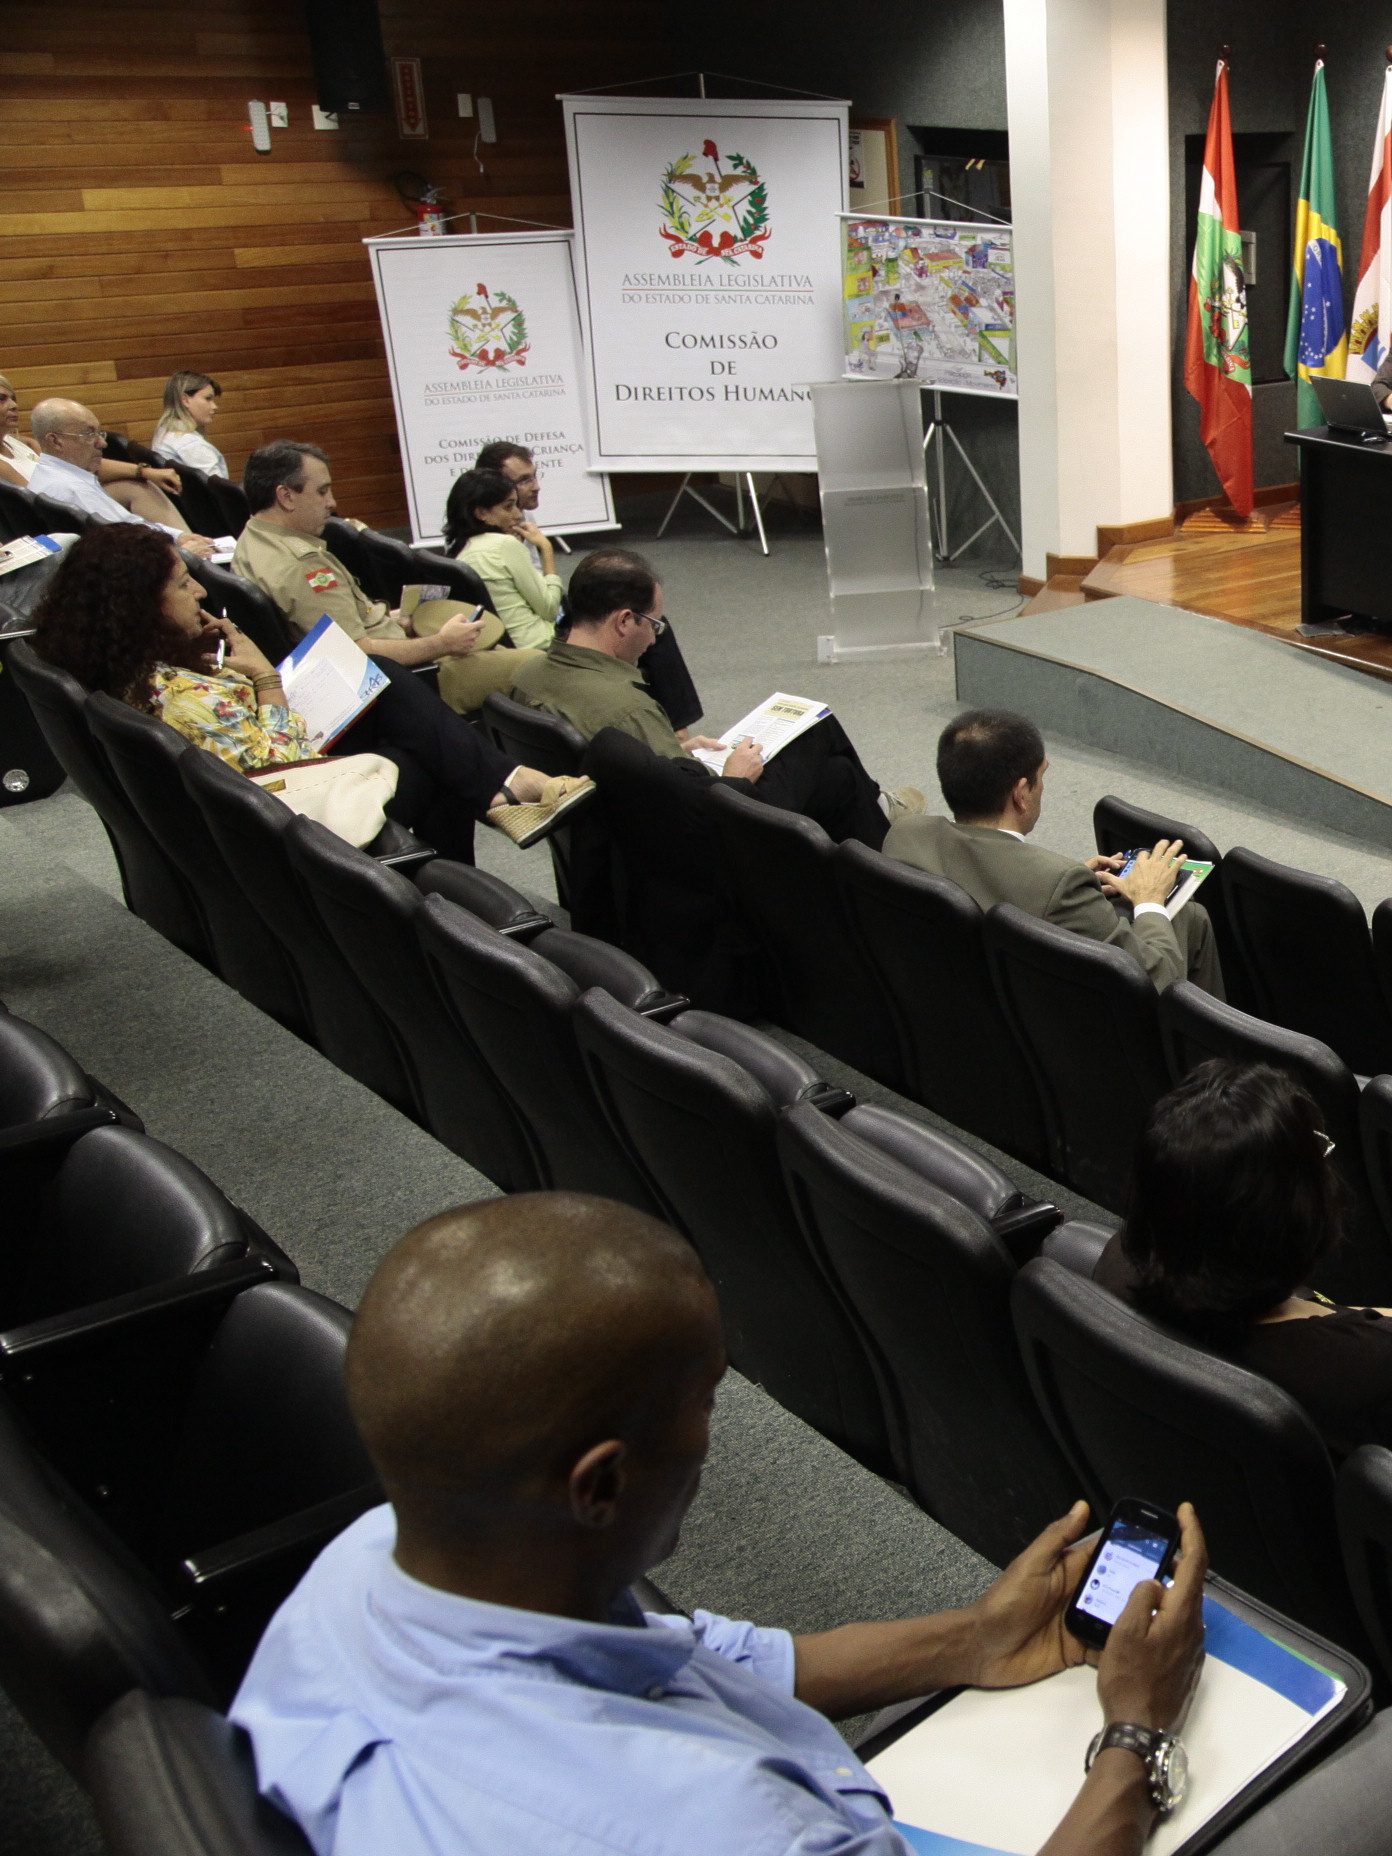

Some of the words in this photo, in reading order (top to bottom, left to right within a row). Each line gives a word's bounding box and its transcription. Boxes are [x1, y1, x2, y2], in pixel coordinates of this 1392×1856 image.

[622, 273, 714, 287] ASSEMBLEIA
[719, 274, 813, 288] LEGISLATIVA
[622, 293, 642, 304] DO
[645, 293, 692, 304] ESTADO
[695, 294, 711, 304] DE
[714, 294, 752, 305] SANTA
[754, 294, 815, 305] CATARINA
[665, 331, 778, 349] COMISSÃO
[710, 361, 737, 375] DE
[424, 379, 492, 394] ASSEMBLEIA
[496, 374, 564, 389] LEGISLATIVA
[615, 384, 715, 401] DIREITOS
[724, 385, 812, 402] HUMAN
[424, 398, 439, 407] DO
[442, 395, 477, 405] ESTADO
[479, 394, 491, 403] DE
[493, 392, 521, 402] SANTA
[522, 388, 567, 399] CATARINA
[439, 435, 501, 450] COMISSÃO
[505, 435, 521, 444] DE
[524, 431, 566, 443] DEFESA
[424, 454, 449, 465] DOS
[531, 443, 584, 456] CRIANÇA
[450, 468, 456, 477] E
